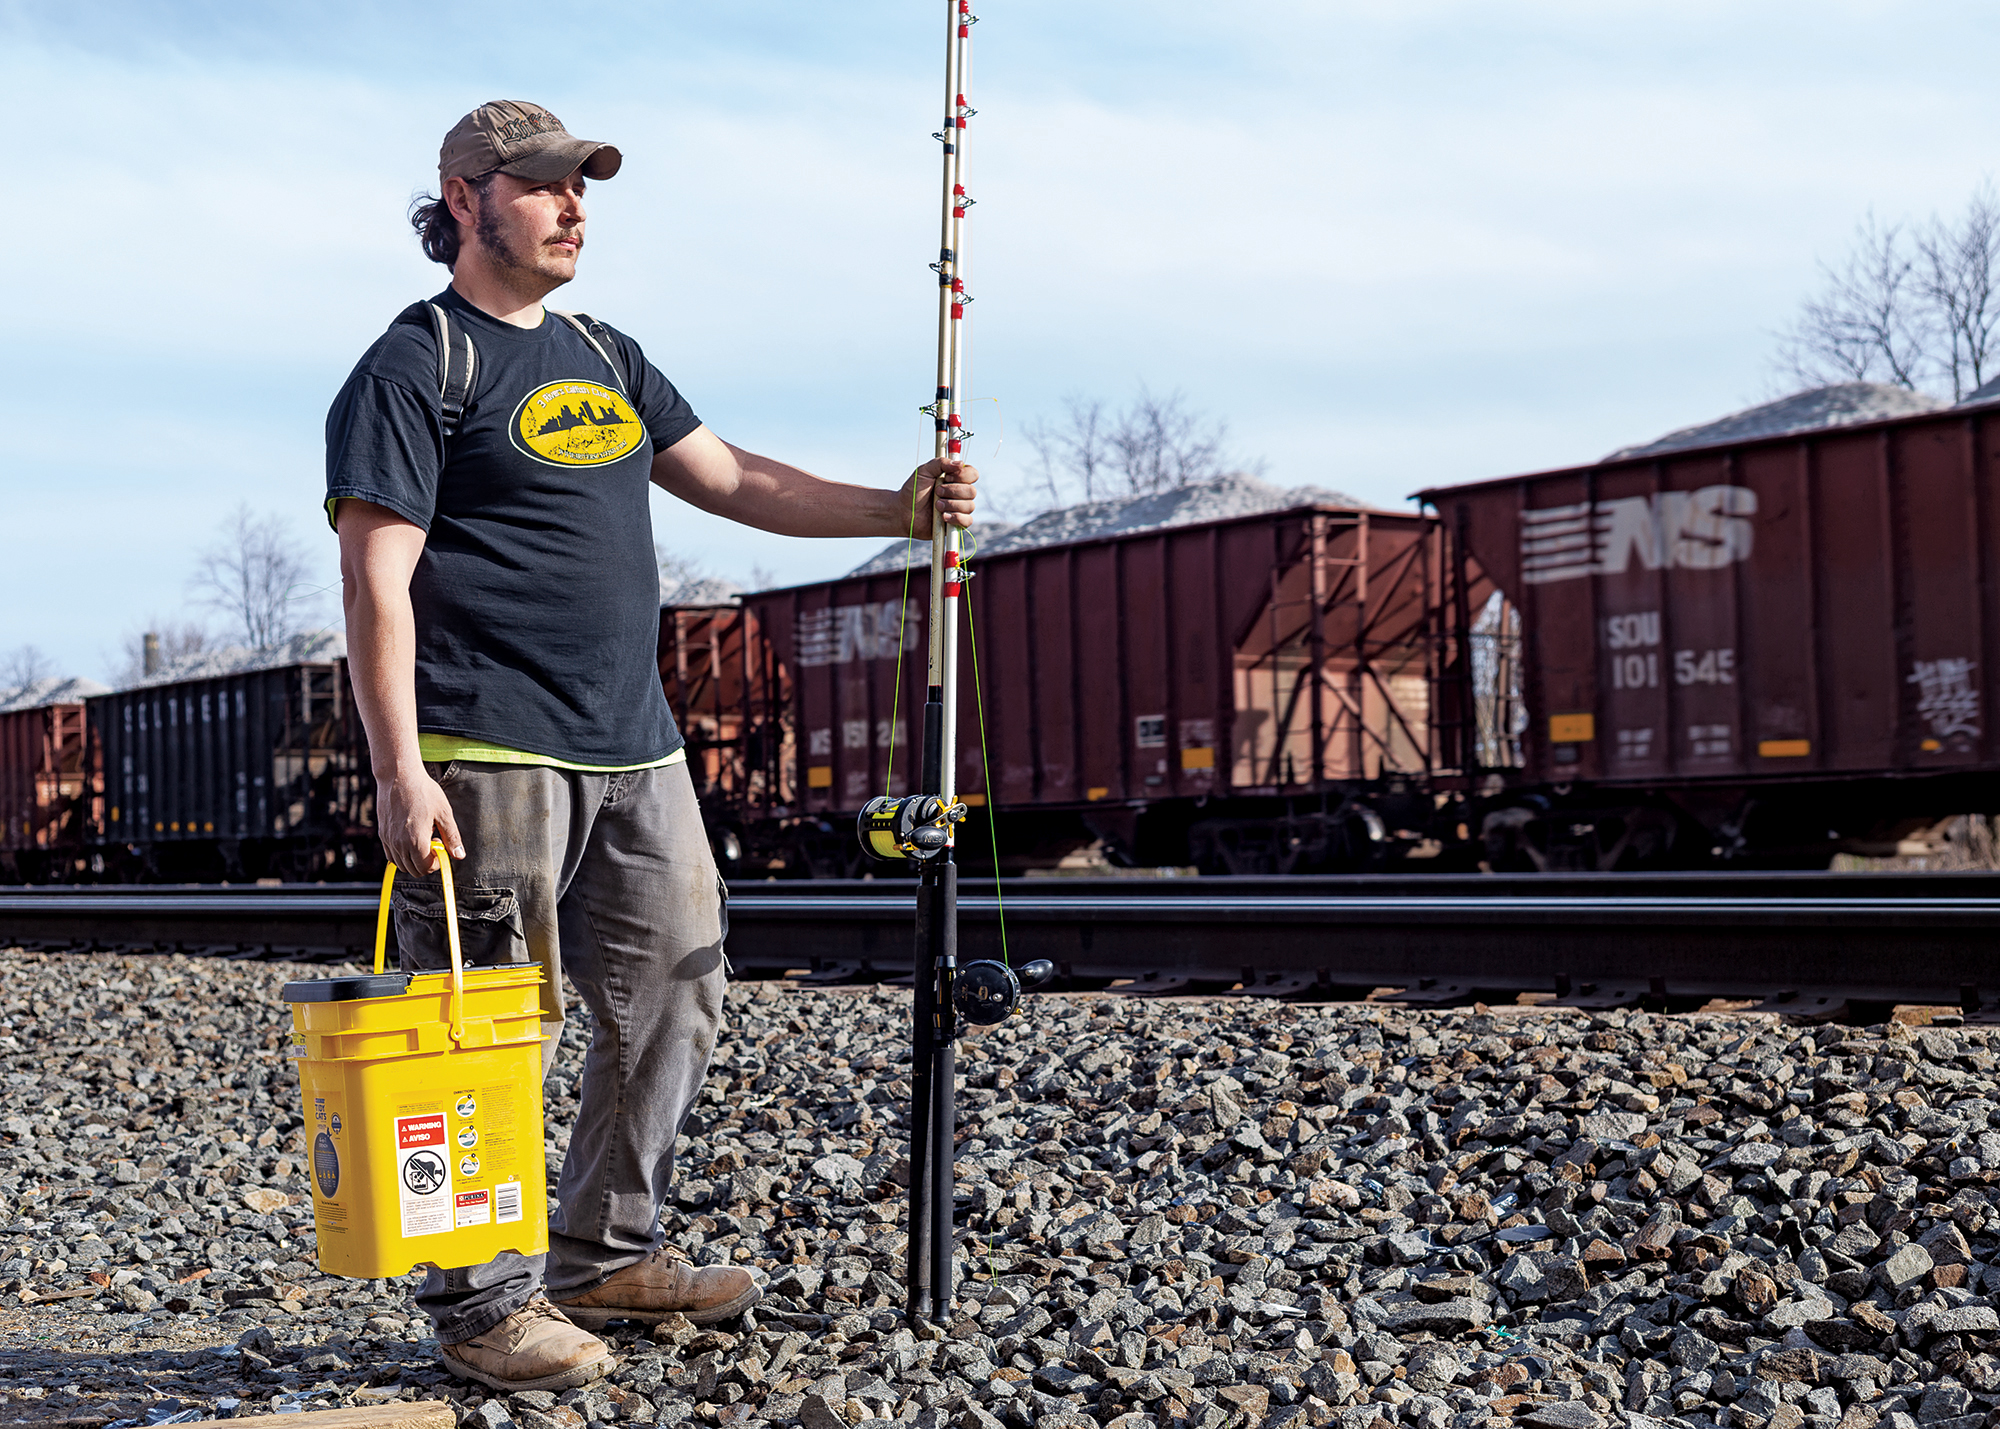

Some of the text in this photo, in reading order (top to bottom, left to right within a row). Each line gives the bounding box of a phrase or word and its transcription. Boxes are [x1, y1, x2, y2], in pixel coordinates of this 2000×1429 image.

[536, 385, 611, 409] 3 Rivers Catfish Club
[1596, 484, 1758, 574] NS
[834, 597, 923, 664] NS
[1607, 610, 1661, 651] SOU
[1612, 649, 1735, 689] 101 545
[314, 1104, 326, 1112] TIDY
[315, 1112, 327, 1121] CATS
[407, 1120, 442, 1132] WARNING
[408, 1132, 431, 1143] AVISO
